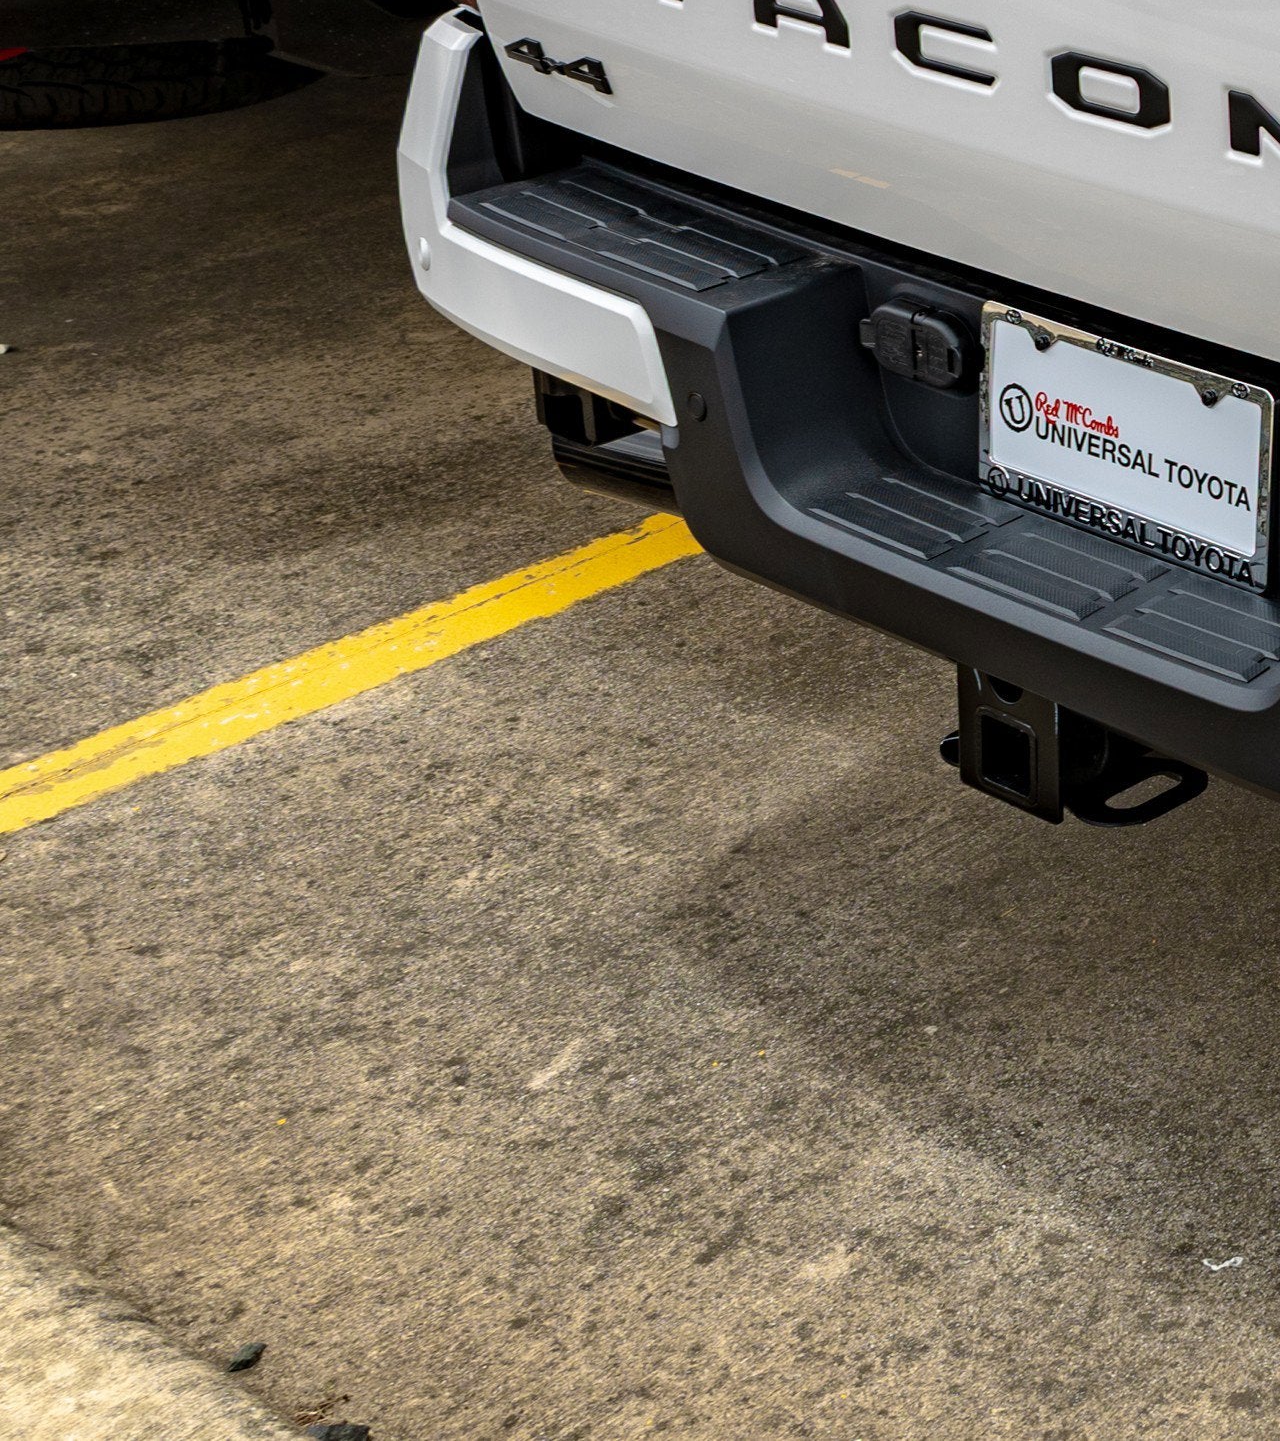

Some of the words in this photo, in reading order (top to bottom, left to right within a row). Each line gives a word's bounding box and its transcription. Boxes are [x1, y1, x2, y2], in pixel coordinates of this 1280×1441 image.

[1035, 391, 1060, 424] Red
[1063, 399, 1119, 438] McCombs
[1035, 416, 1160, 478] UNIVERSAL
[1164, 458, 1251, 511] TOYOTA
[1018, 475, 1155, 546] UNIVERSAL
[1156, 526, 1255, 587] TOYOTA
